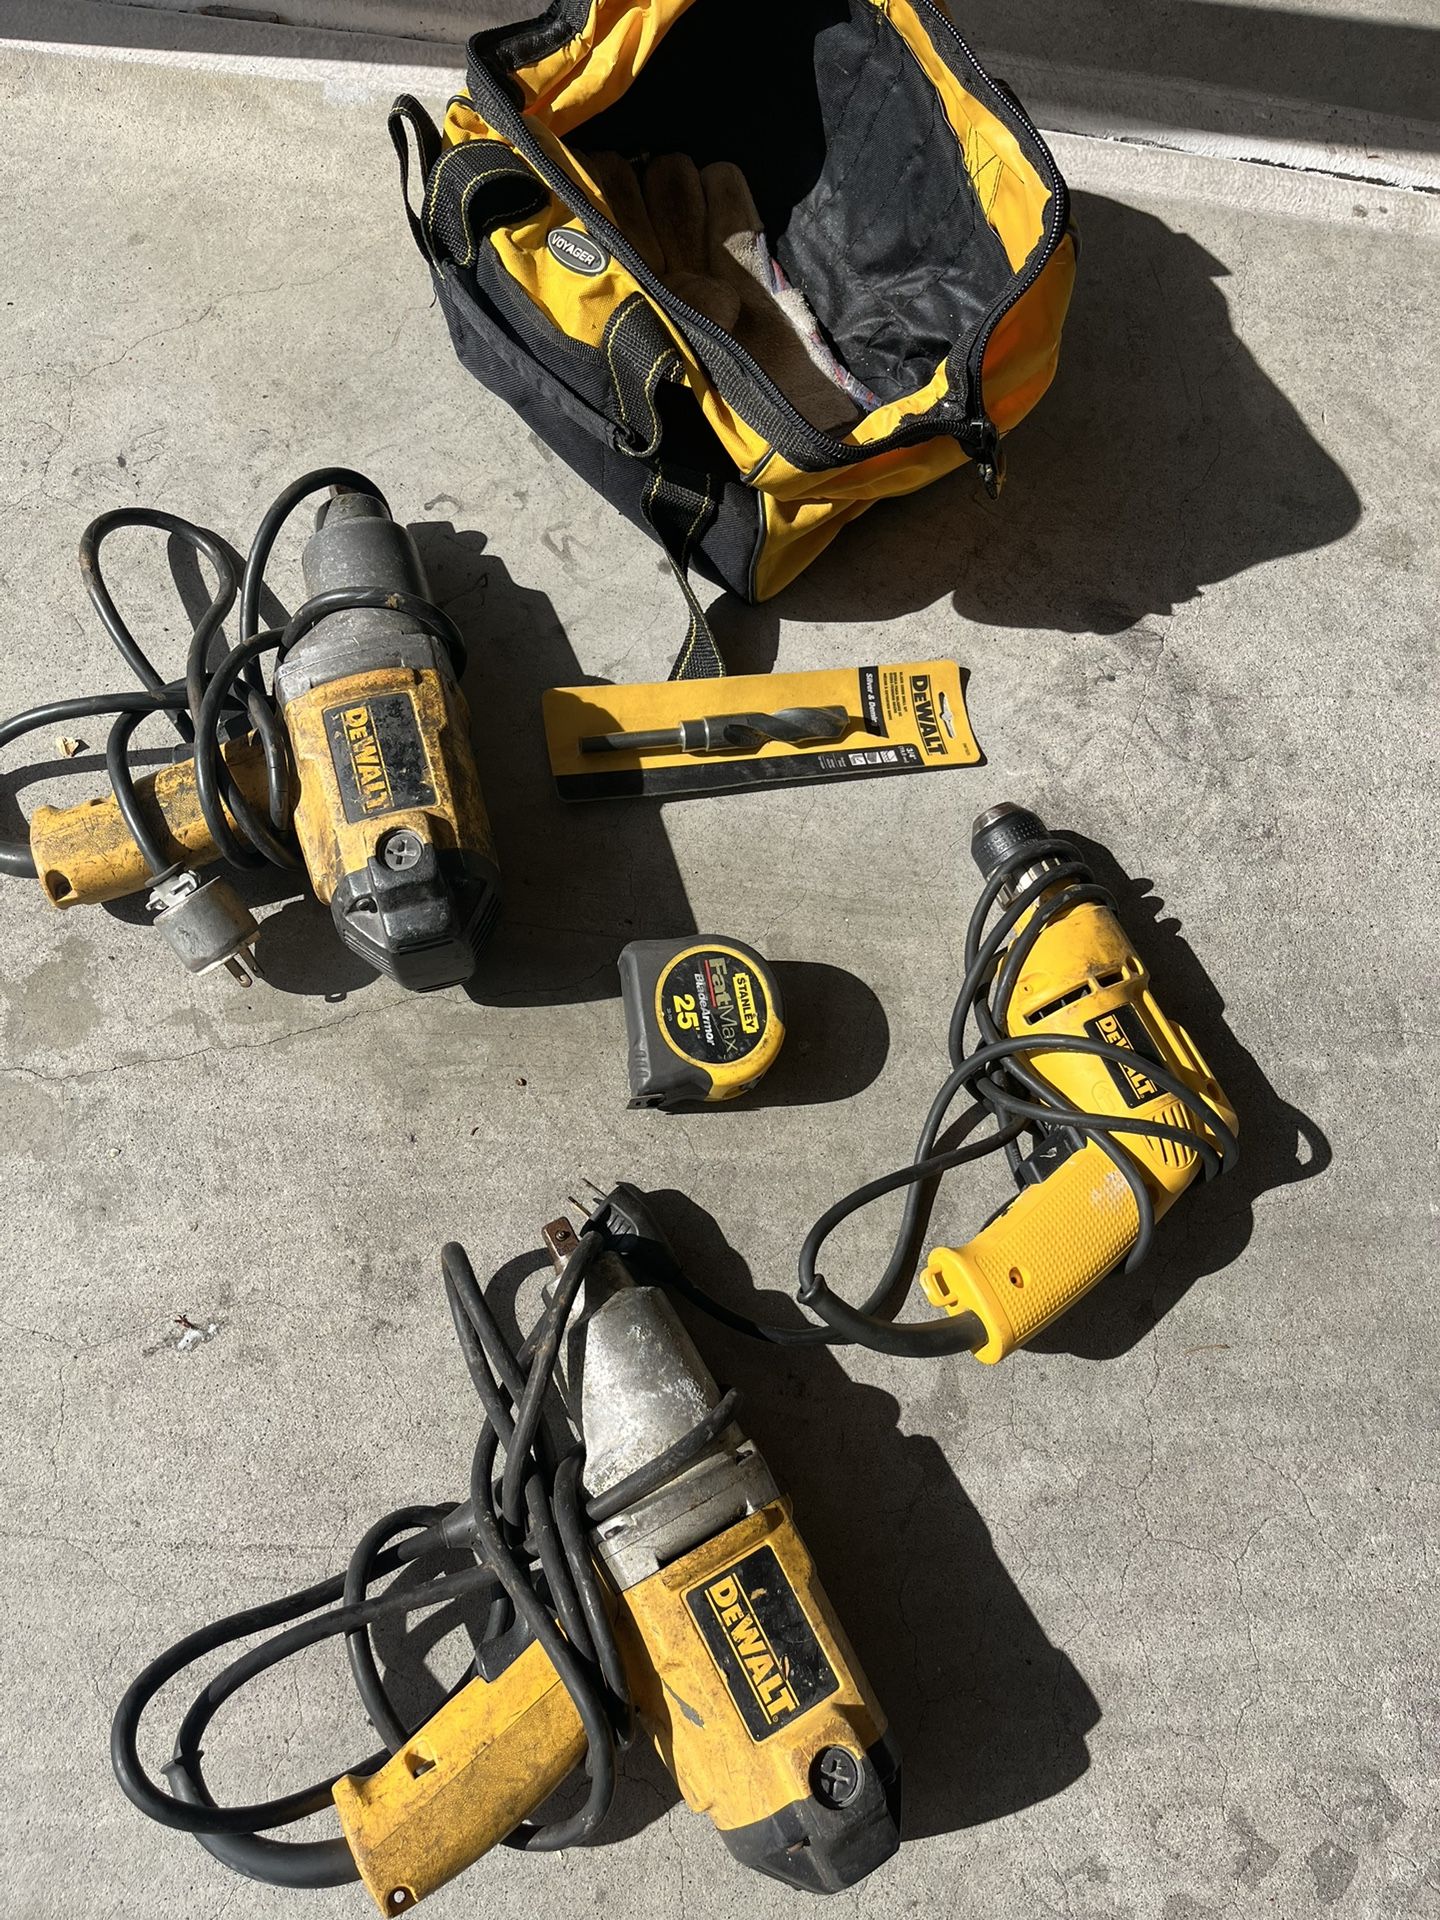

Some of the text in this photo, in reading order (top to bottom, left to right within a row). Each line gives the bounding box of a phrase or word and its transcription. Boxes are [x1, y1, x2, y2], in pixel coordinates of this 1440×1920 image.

[551, 233, 595, 265] VOYAGER
[865, 672, 874, 693] Silver
[868, 693, 876, 701] &
[911, 674, 946, 756] DEWALT
[673, 994, 700, 1031] 25'
[694, 973, 716, 1046] BladeArmor
[708, 957, 739, 1053] FatMax
[737, 977, 756, 1029] STANLEY
[709, 1575, 797, 1716] DEWALT
